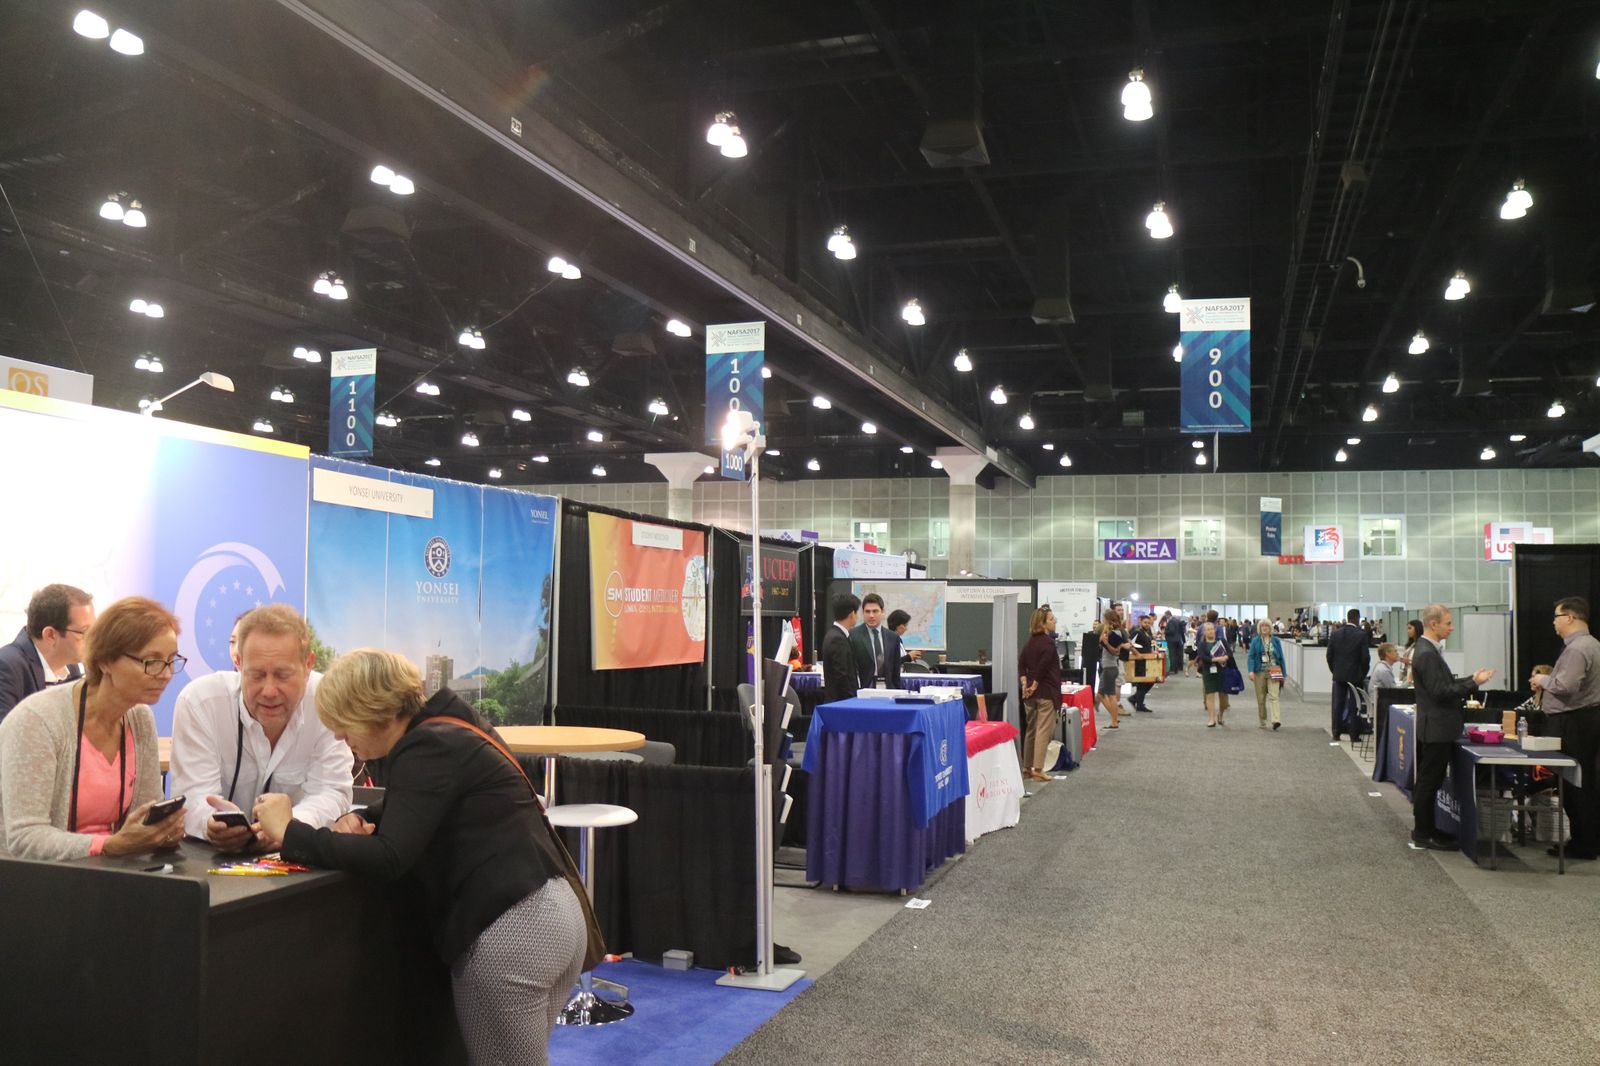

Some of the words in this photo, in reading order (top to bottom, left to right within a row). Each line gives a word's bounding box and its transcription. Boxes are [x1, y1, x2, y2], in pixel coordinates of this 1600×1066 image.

[1205, 304, 1245, 312] NAFSA2017
[727, 328, 760, 336] NAFSA2017
[729, 358, 741, 412] 100
[1208, 347, 1222, 409] 900
[346, 380, 357, 447] 1100
[725, 452, 743, 472] 1000
[349, 485, 370, 498] YONSEI
[371, 488, 403, 503] UNIVERSITY
[1108, 541, 1172, 558] KOREA
[763, 556, 795, 581] UCIEP
[415, 580, 459, 595] YONSEI
[607, 587, 622, 601] SM
[624, 587, 652, 602] STUDENT
